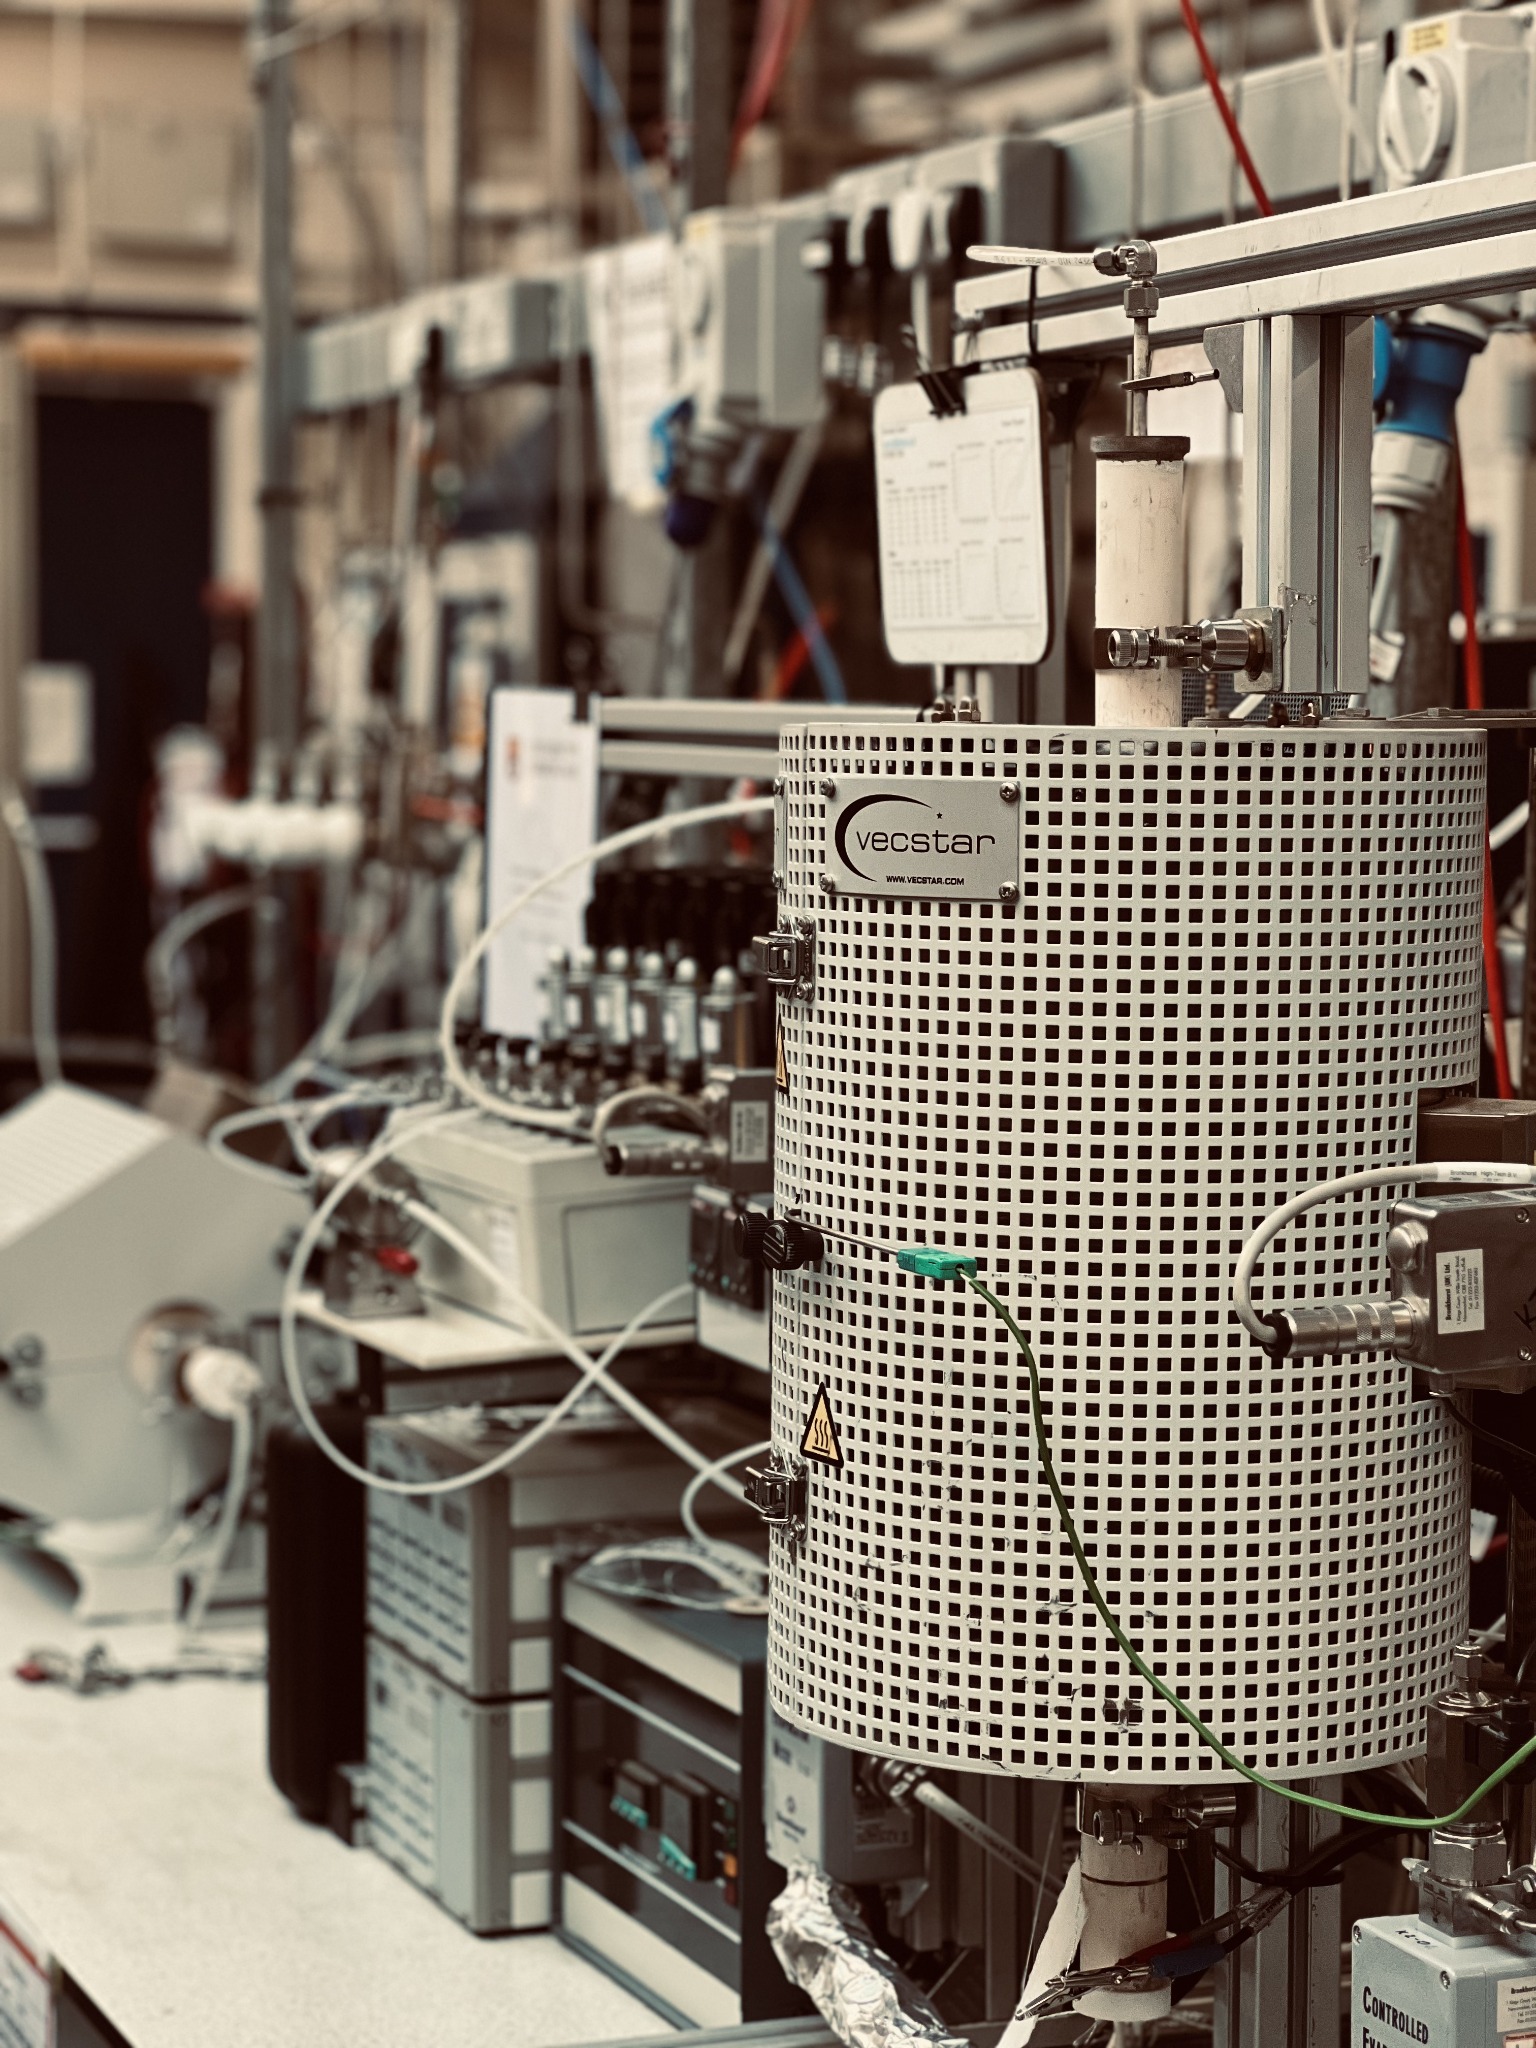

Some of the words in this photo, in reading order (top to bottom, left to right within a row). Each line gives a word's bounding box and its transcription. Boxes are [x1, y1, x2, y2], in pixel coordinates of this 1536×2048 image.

[856, 830, 996, 855] vecstar
[886, 875, 964, 886] WWW.VECSTAR.COM
[1363, 1986, 1429, 2044] CONTROLLED
